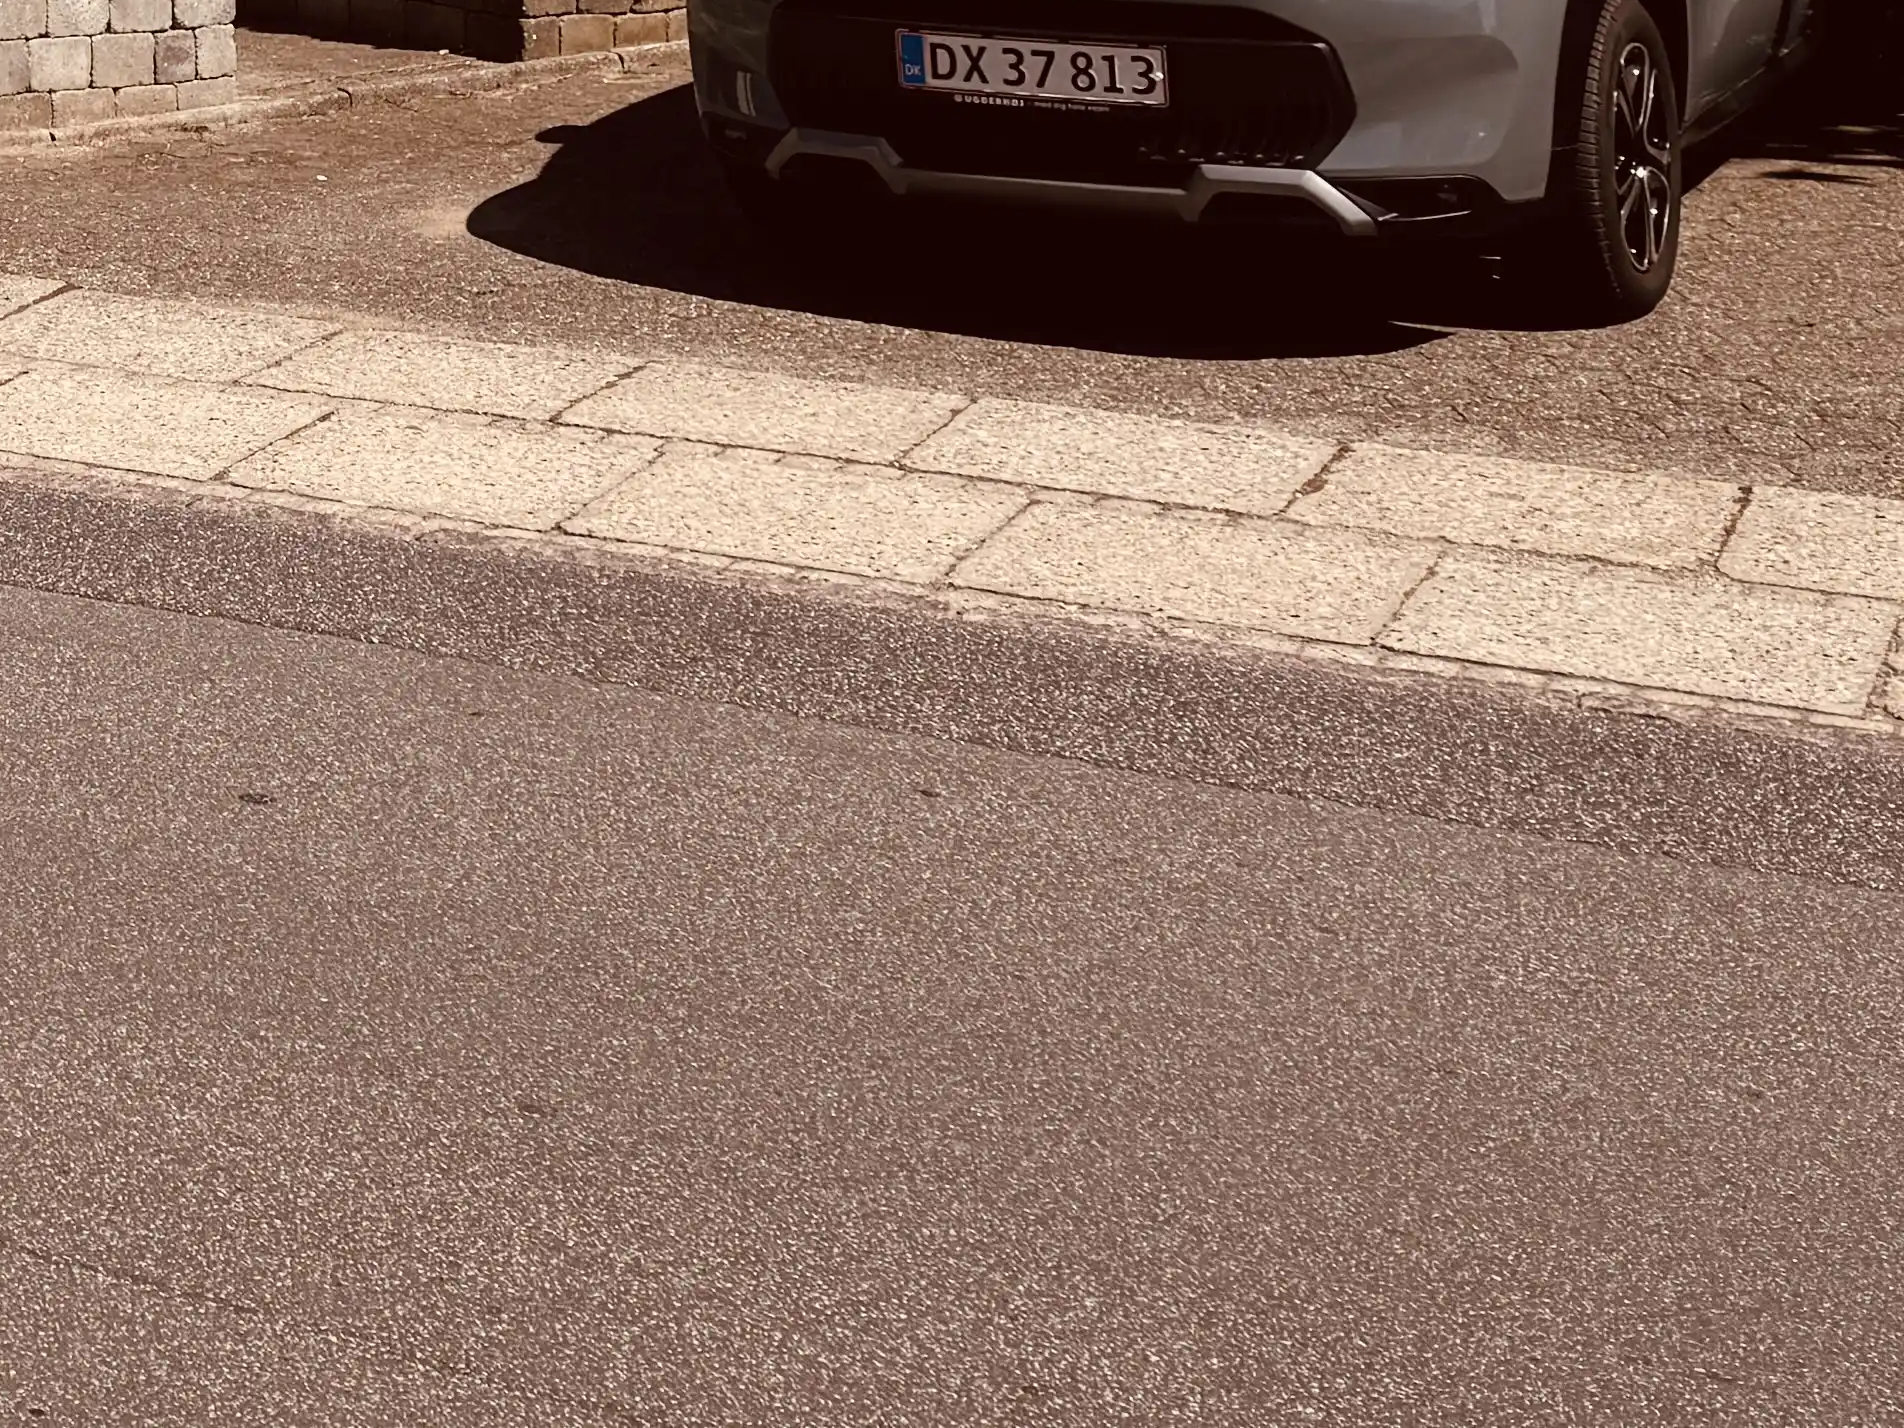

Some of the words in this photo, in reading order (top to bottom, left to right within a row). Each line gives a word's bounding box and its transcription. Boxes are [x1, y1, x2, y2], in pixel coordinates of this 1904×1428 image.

[904, 64, 922, 76] DK
[929, 42, 990, 84] DX
[1001, 47, 1056, 88] 37
[1069, 51, 1158, 95] 813
